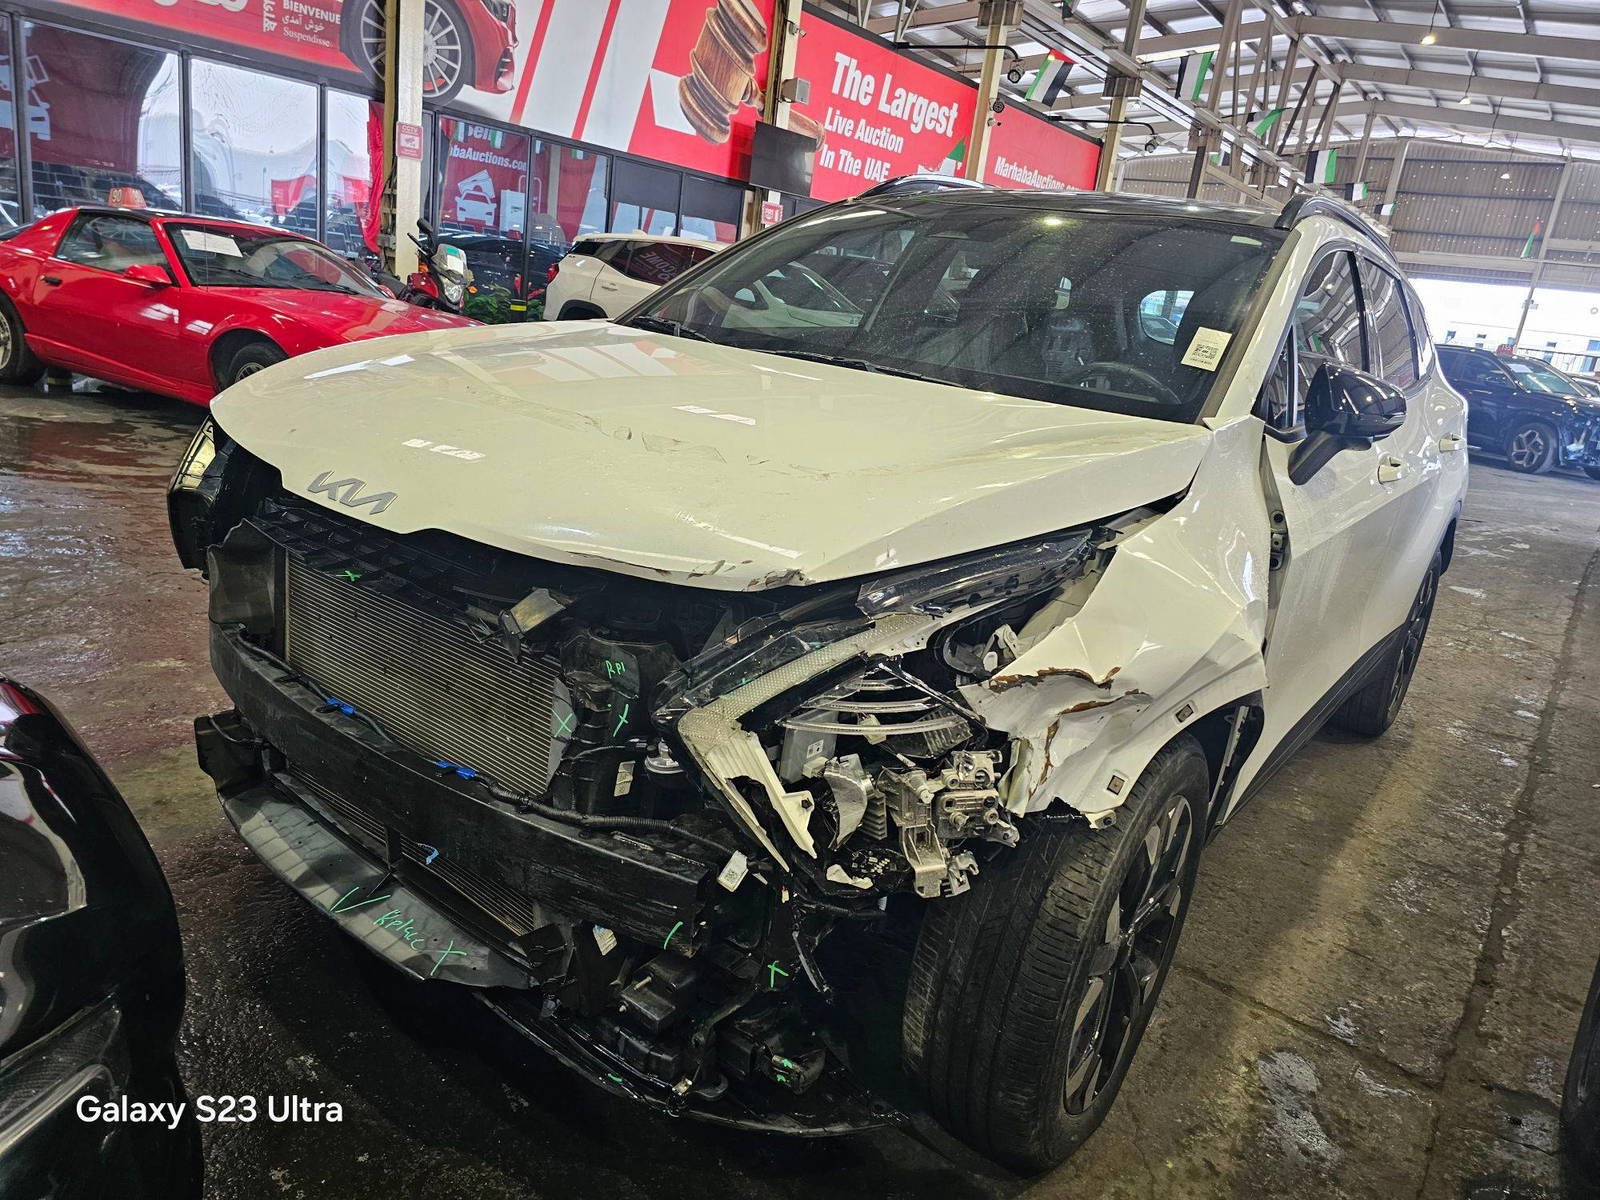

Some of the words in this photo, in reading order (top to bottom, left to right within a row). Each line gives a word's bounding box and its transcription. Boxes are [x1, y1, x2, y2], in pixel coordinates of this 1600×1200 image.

[283, 0, 341, 24] BIENVENUE
[283, 26, 331, 48] Suspendisse
[832, 52, 875, 106] The
[878, 73, 959, 138] Largest
[824, 106, 854, 137] Live
[854, 118, 904, 153] Auction
[819, 144, 835, 169] In
[838, 148, 862, 177] The
[864, 156, 891, 182] UAE
[307, 471, 398, 515] KIA
